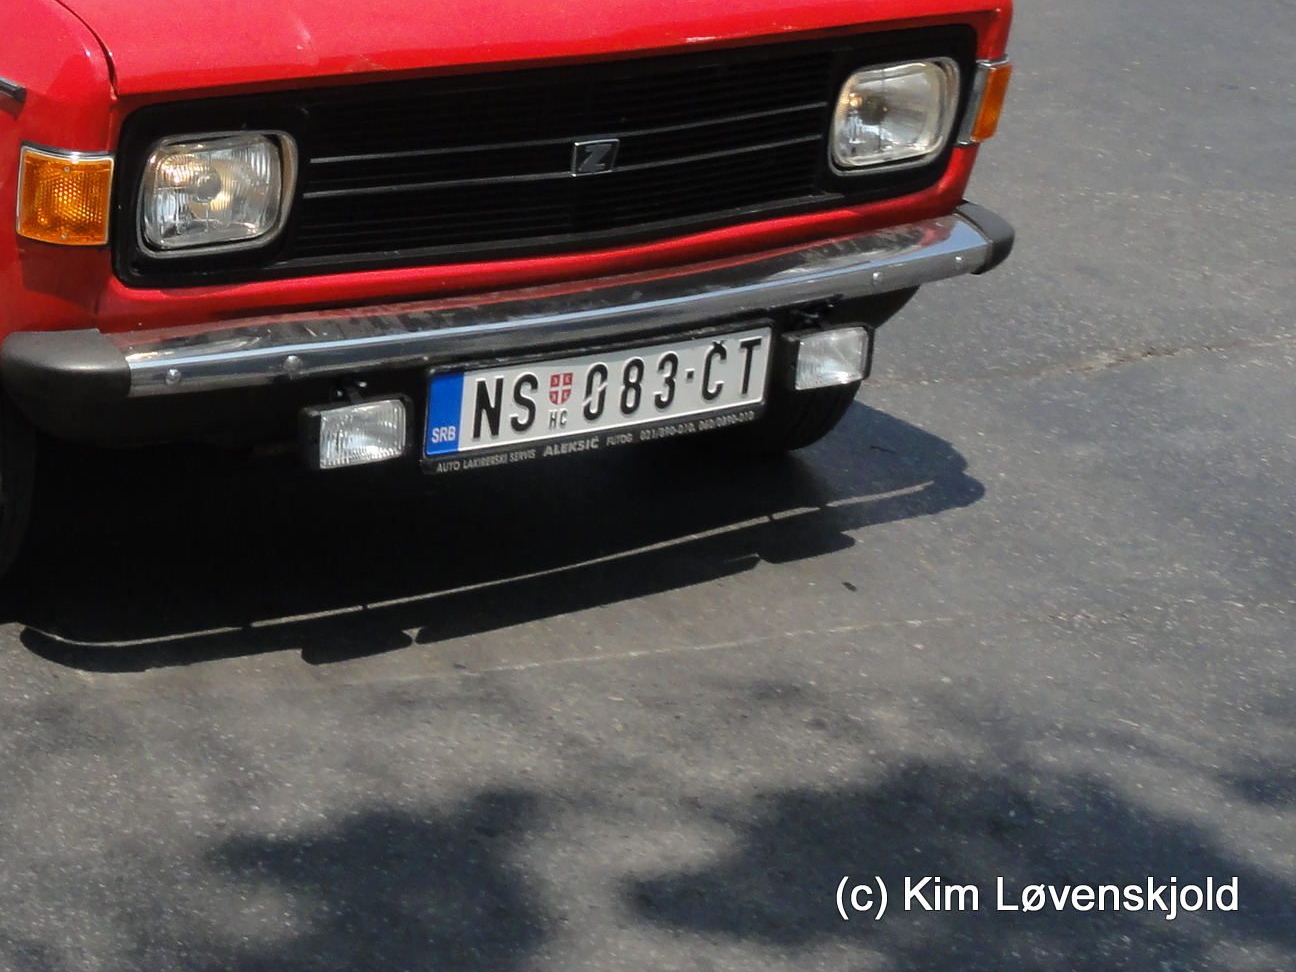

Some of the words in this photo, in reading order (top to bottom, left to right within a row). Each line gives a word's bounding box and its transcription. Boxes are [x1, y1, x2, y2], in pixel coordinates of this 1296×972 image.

[472, 372, 539, 439] NS
[431, 426, 456, 444] SRB
[436, 461, 461, 473] AUTO
[509, 449, 536, 462] SERVIS
